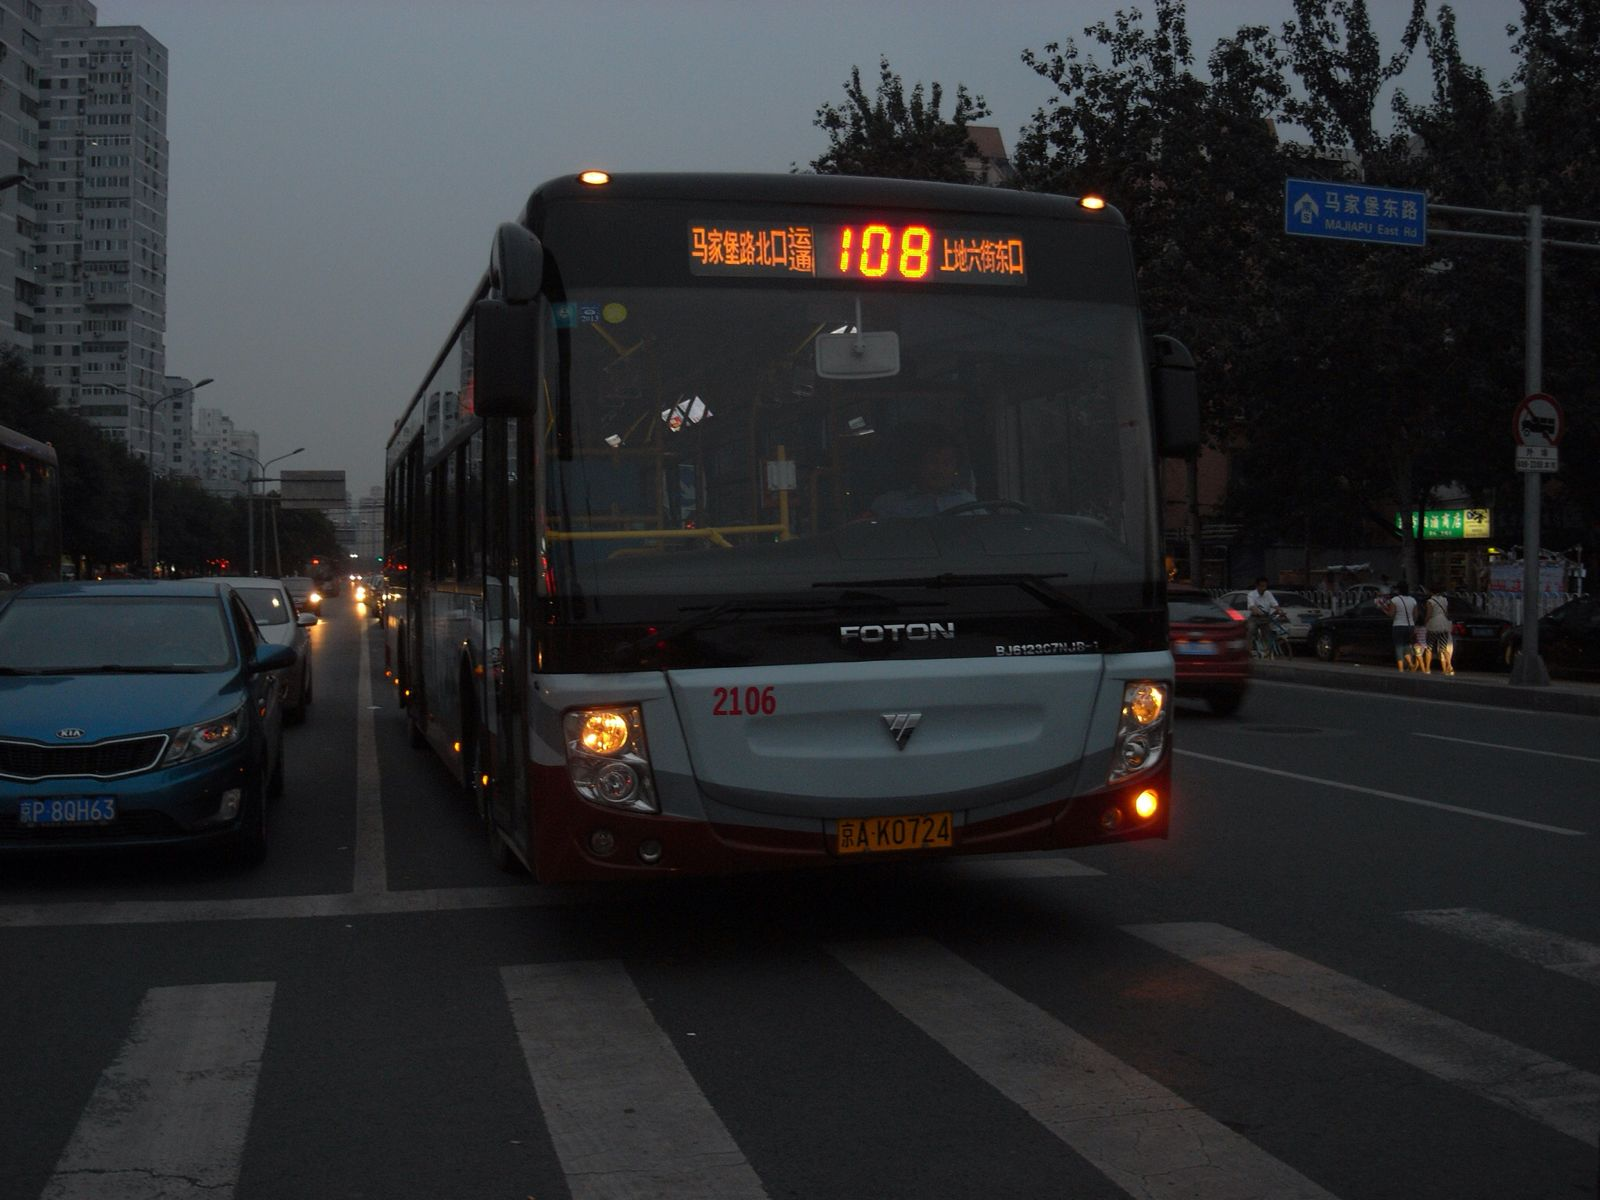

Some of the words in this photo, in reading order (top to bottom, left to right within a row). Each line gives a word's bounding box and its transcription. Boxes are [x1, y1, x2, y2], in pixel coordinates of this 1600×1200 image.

[1324, 191, 1418, 220] 马家堡东路
[1324, 219, 1373, 233] MAJIAPU
[1376, 224, 1399, 236] East
[1403, 227, 1417, 238] Rd
[691, 227, 787, 266] 马家堡路北口
[788, 227, 813, 273] 运通
[839, 225, 931, 278] 108
[940, 238, 1024, 274] 上地六街东口
[839, 622, 956, 644] FOTON
[712, 686, 776, 716] 2106
[60, 729, 81, 738] KIA
